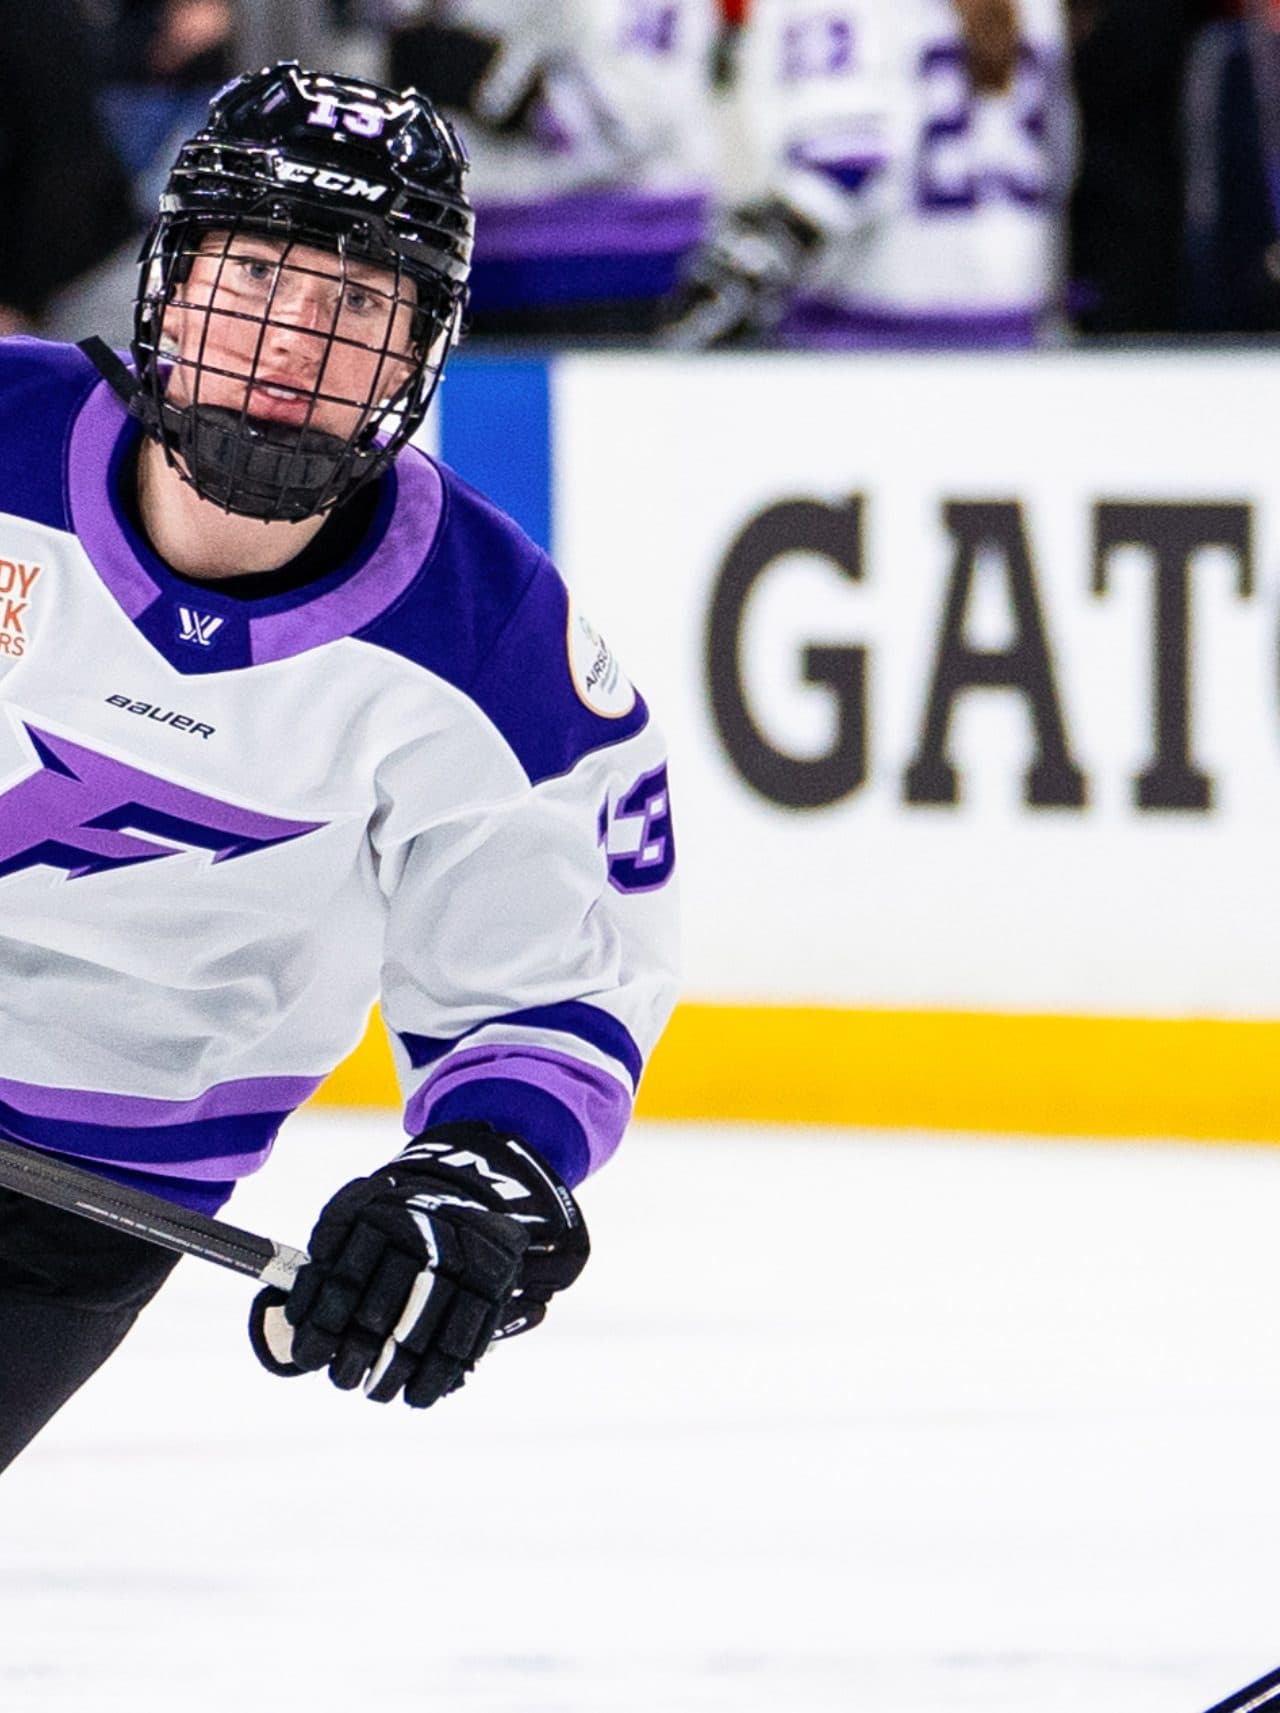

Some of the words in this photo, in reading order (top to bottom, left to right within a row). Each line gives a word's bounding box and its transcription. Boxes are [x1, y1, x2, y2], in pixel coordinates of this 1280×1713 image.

[306, 93, 384, 138] 13
[277, 164, 387, 201] CCM
[706, 494, 1280, 811] GAT
[597, 756, 676, 894] 3
[394, 1143, 531, 1200] CM
